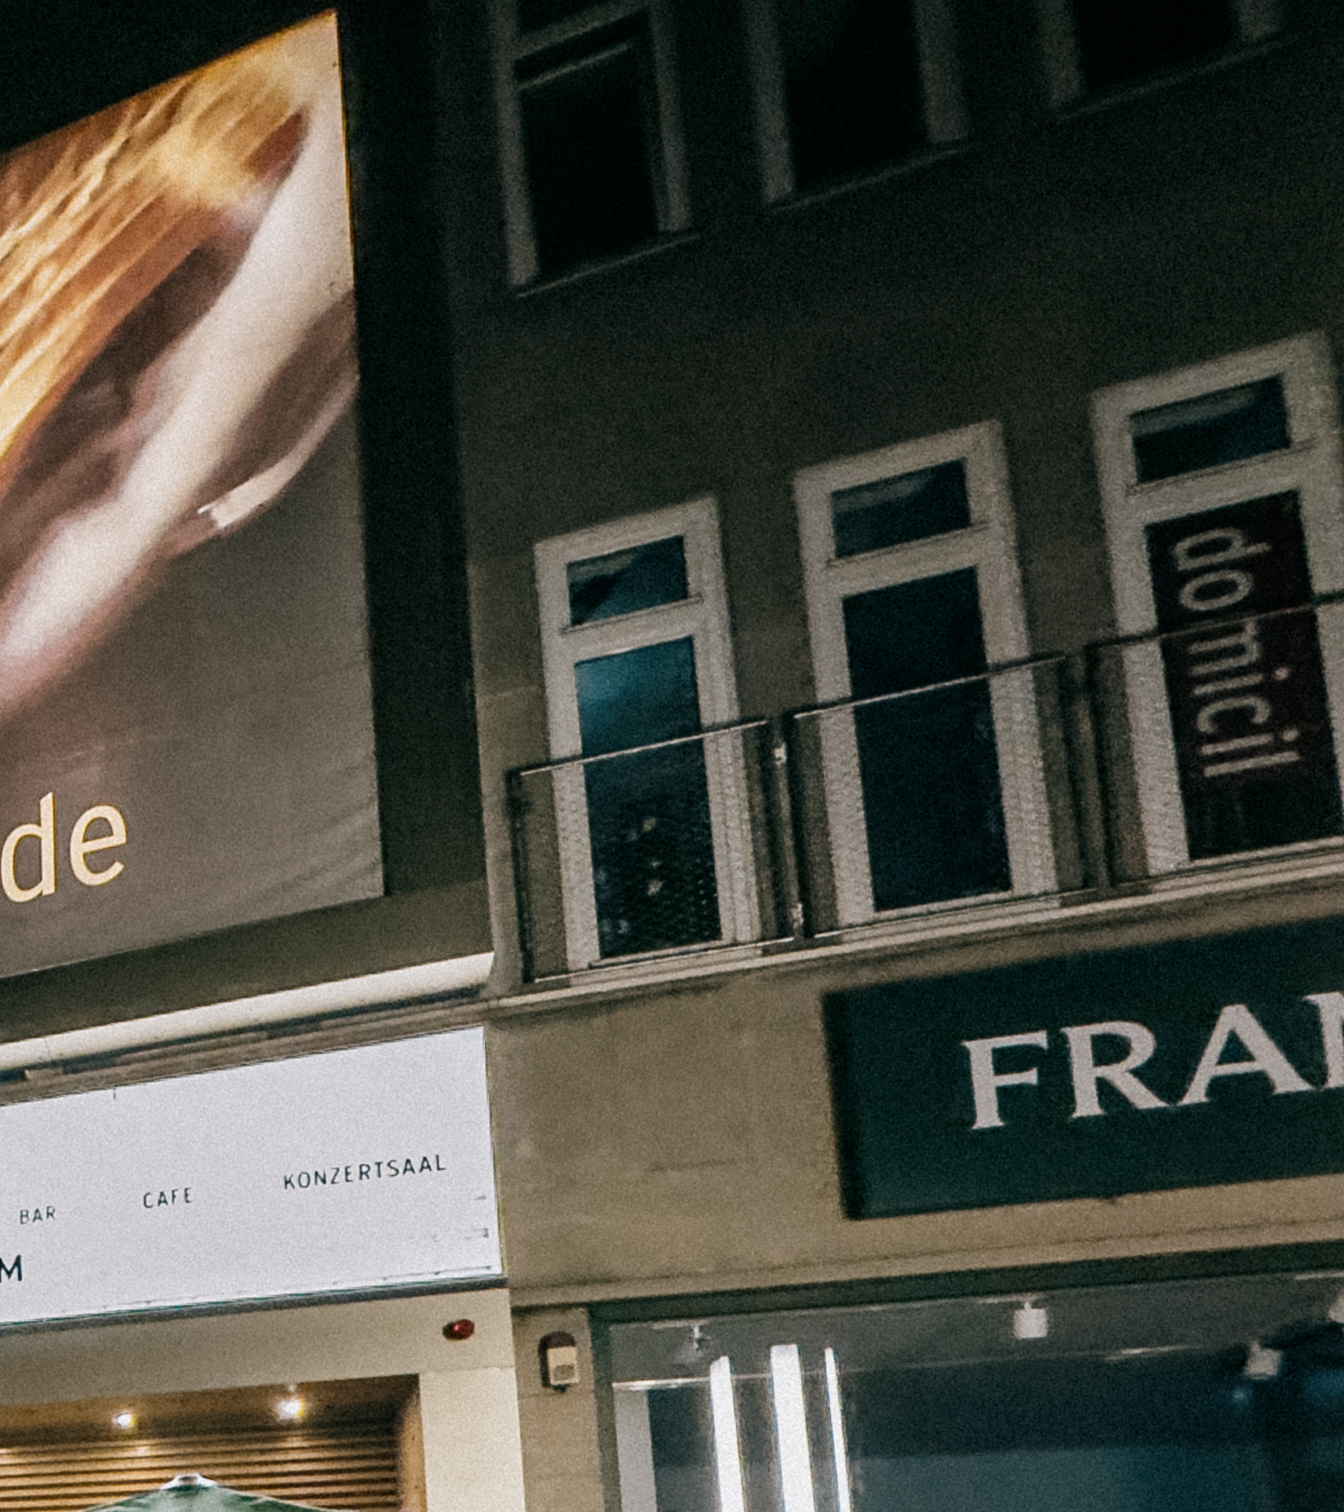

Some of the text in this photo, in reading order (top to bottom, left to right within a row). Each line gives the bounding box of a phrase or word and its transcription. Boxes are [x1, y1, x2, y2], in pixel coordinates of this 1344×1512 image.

[1169, 526, 1302, 779] domicil
[283, 1153, 447, 1190] KONZERTSAAL
[142, 1186, 192, 1209] CAFE
[19, 1205, 56, 1225] BAR
